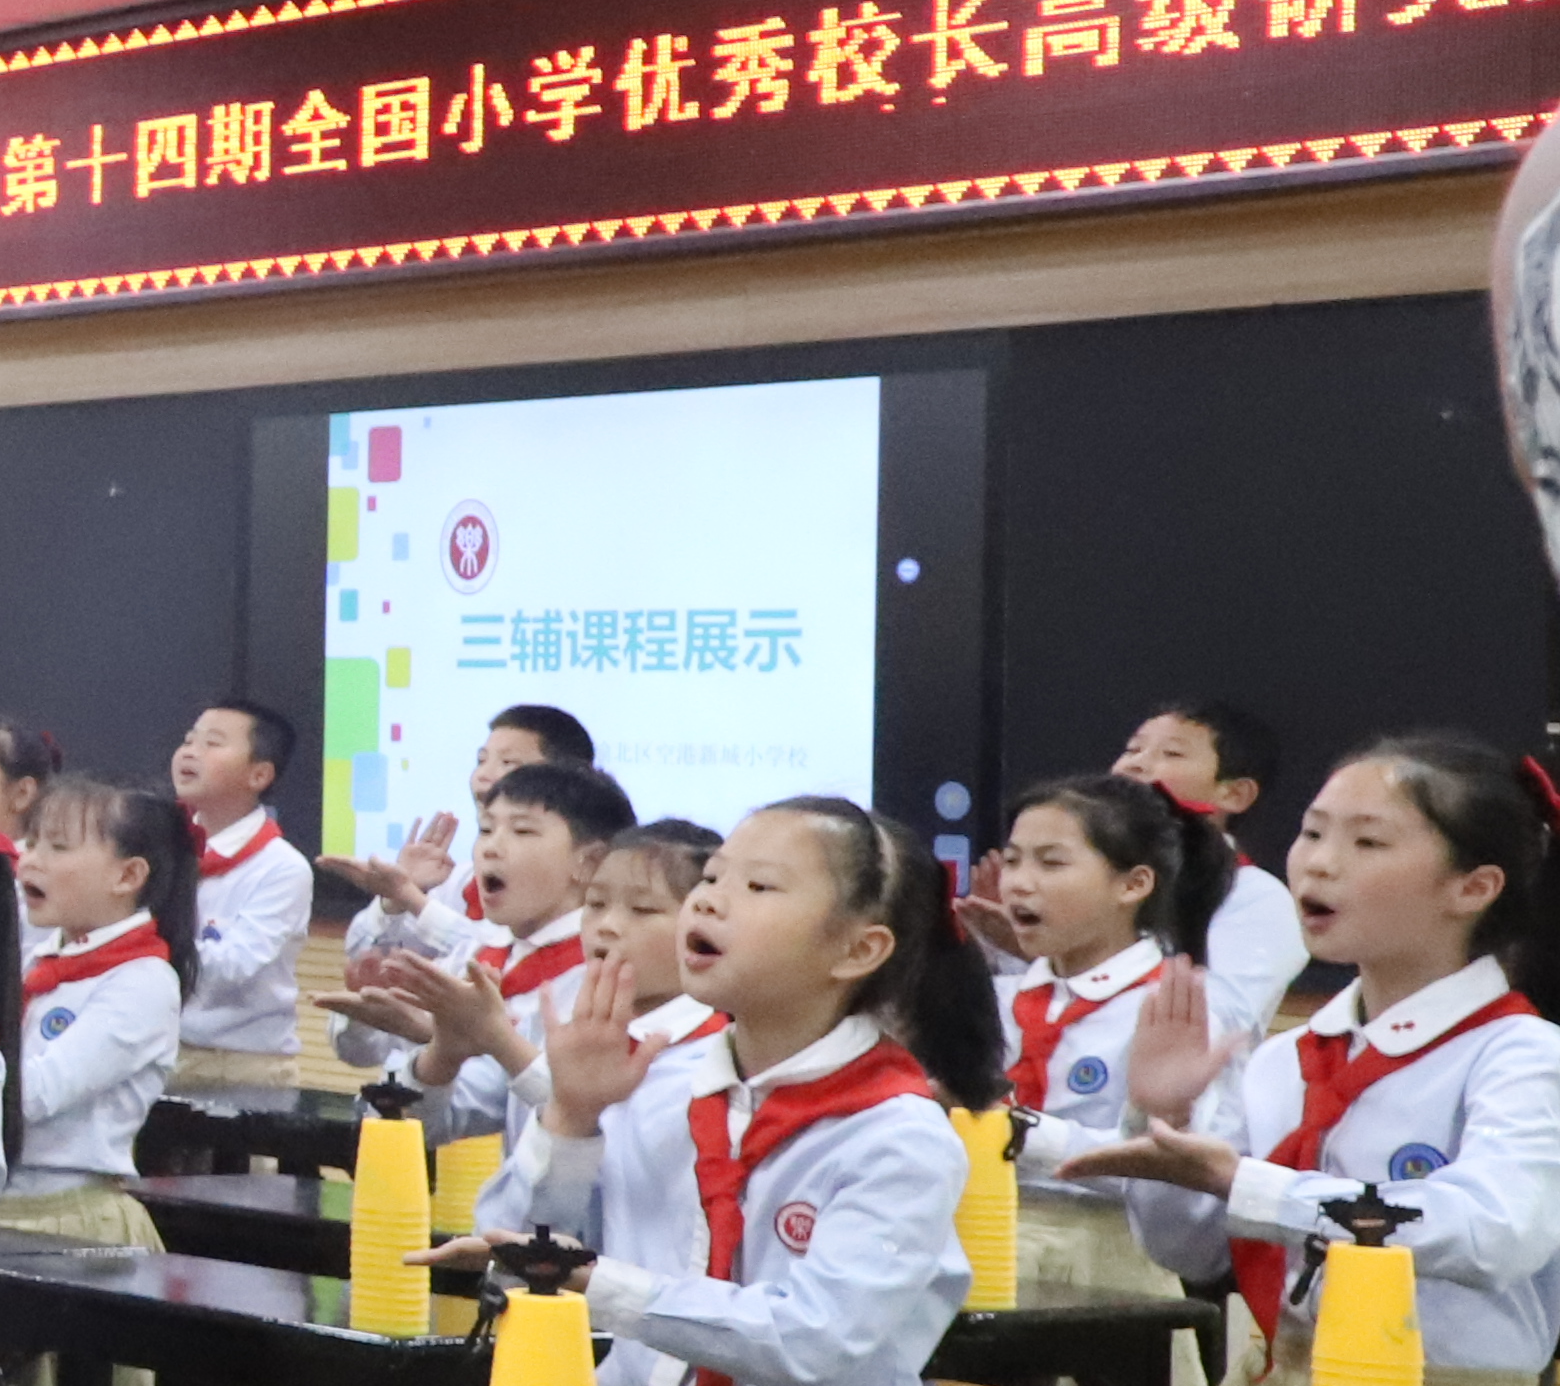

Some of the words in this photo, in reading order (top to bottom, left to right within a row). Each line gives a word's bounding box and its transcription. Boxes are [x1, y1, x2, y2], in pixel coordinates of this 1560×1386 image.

[456, 607, 803, 674] 三辅课程展示
